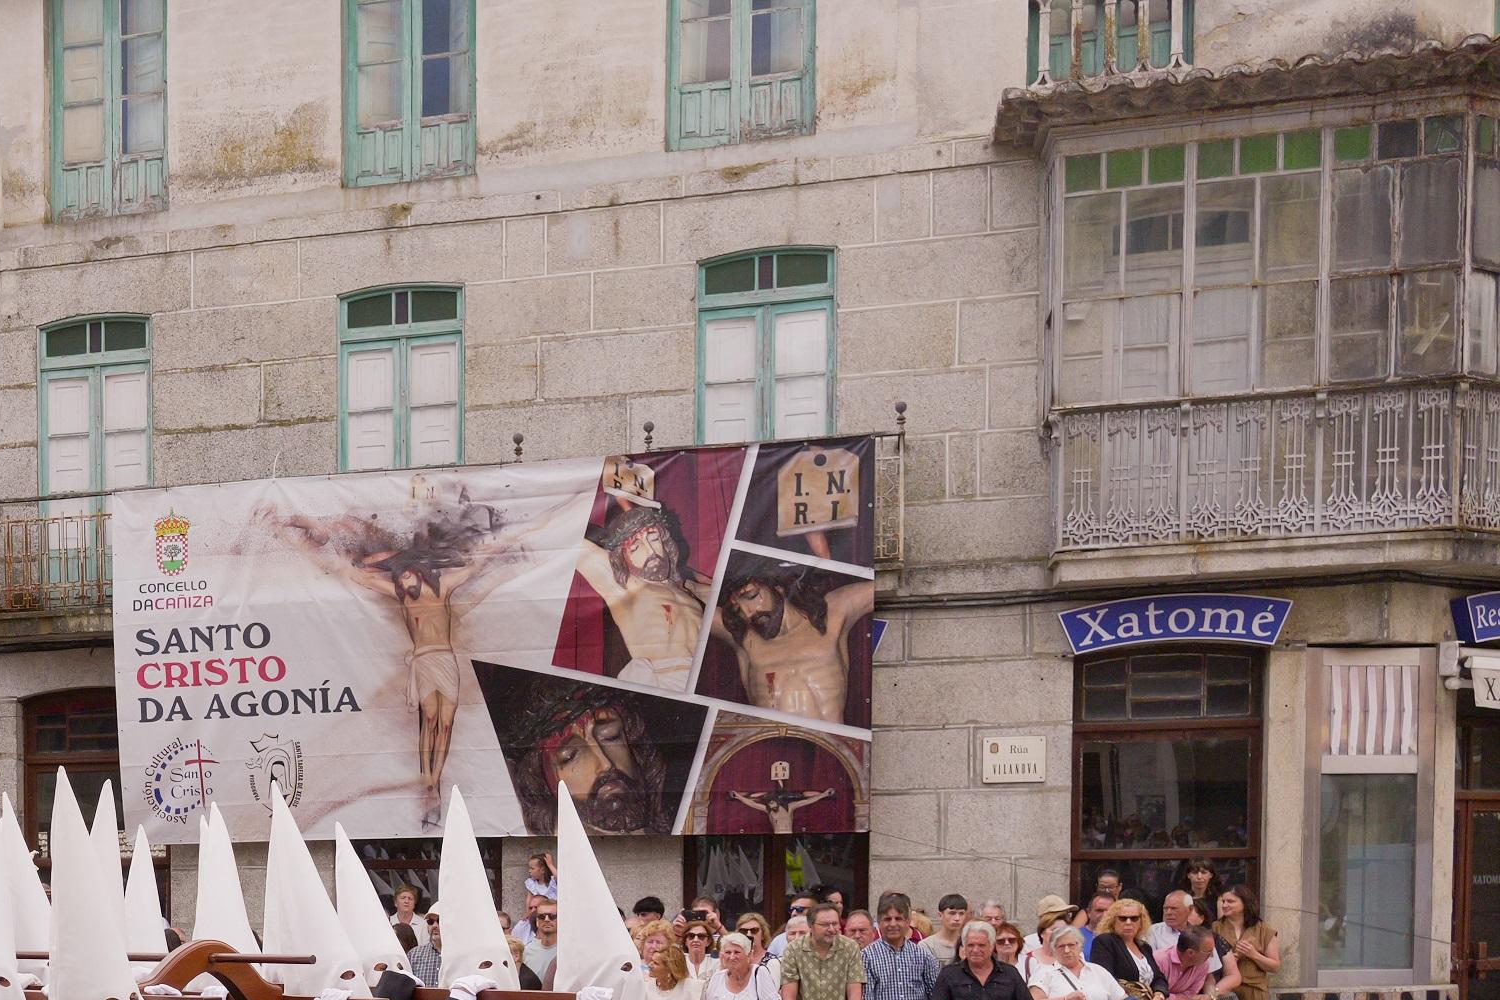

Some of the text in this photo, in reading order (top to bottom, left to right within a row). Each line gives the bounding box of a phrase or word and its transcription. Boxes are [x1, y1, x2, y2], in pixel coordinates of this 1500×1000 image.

[794, 469, 850, 497] I. N.
[793, 502, 816, 525] R.
[139, 580, 207, 594] CONCELLO
[135, 622, 271, 656] SANTO
[1076, 602, 1275, 647] Xatomé
[136, 656, 287, 689] CRISTO
[138, 680, 362, 723] DA AGONÍA
[143, 737, 188, 824] Asociación Cultural
[992, 763, 1037, 775] VILANOVA
